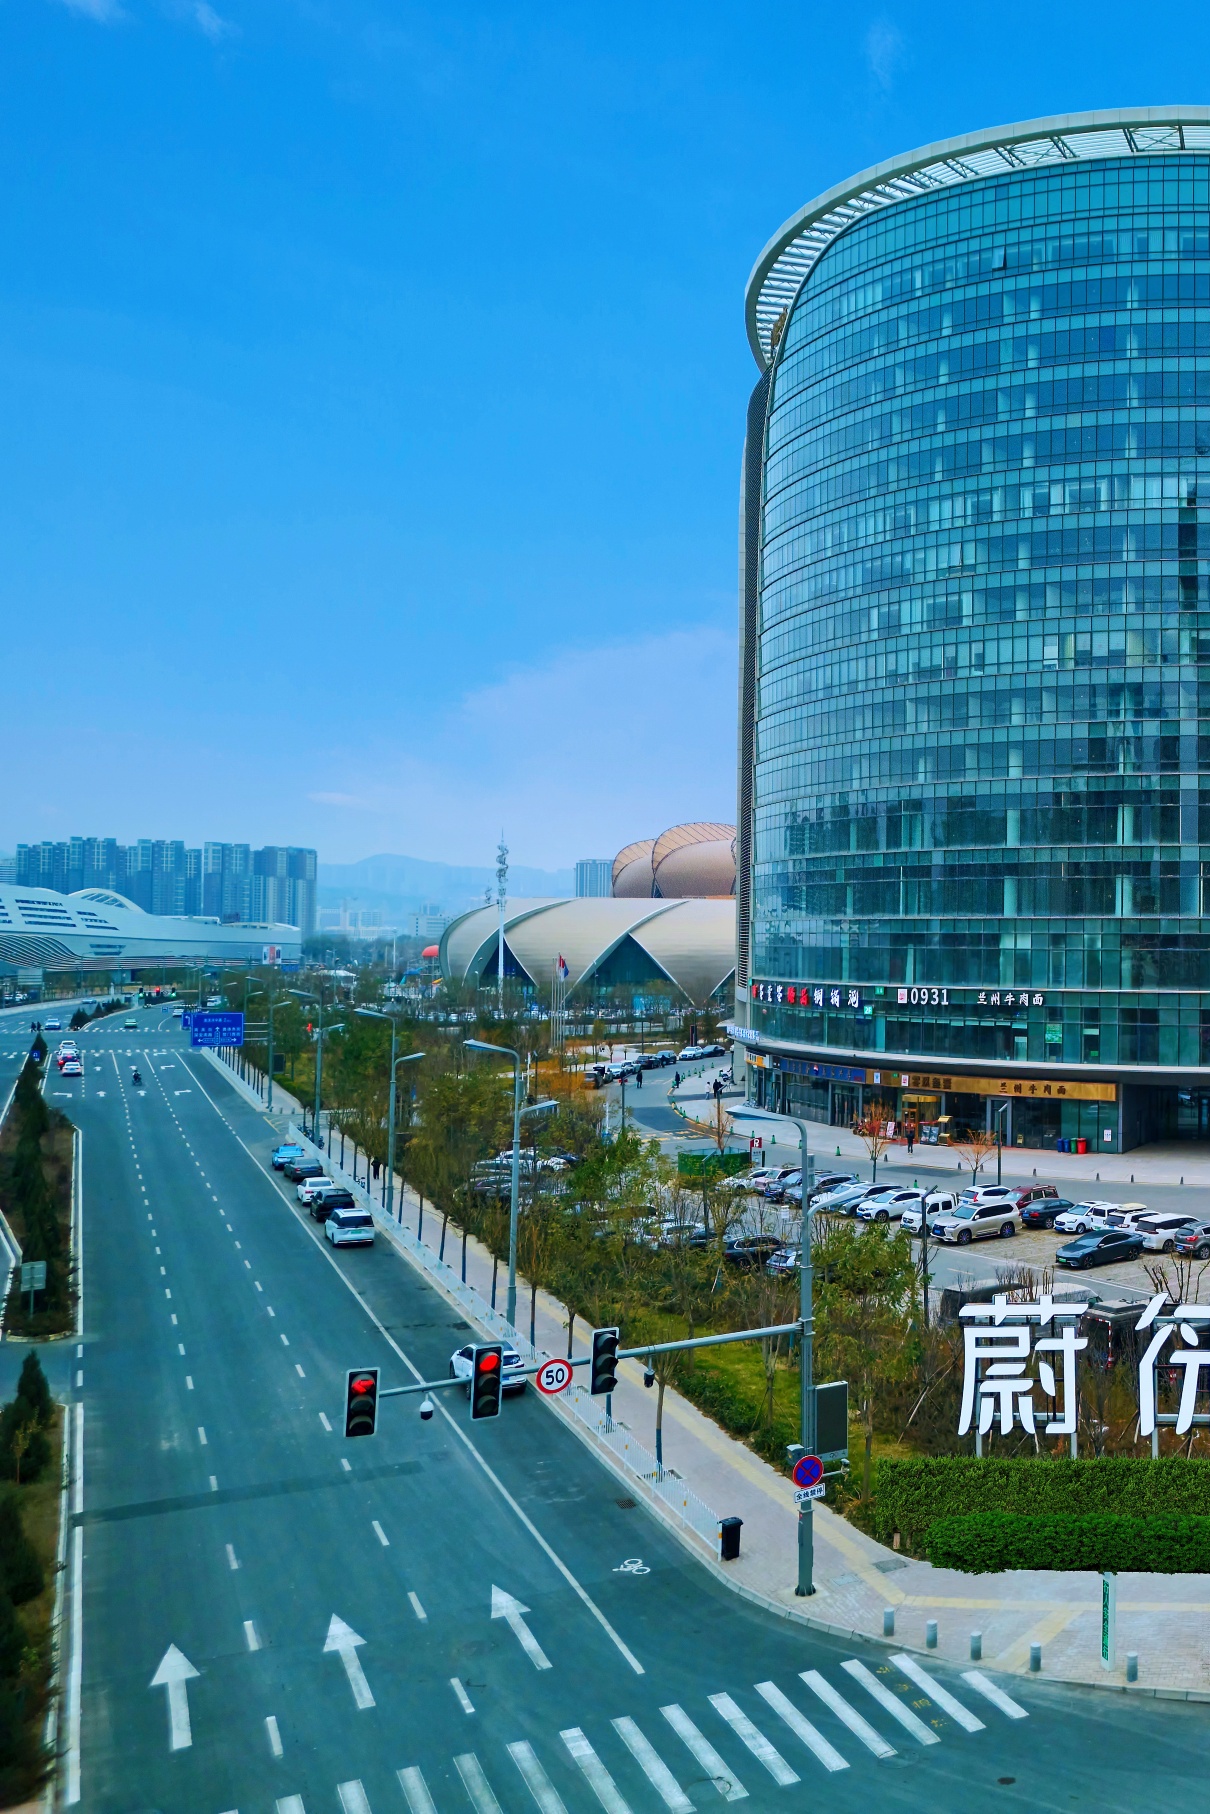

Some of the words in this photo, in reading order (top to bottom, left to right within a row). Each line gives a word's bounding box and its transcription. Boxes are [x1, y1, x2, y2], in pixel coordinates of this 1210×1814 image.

[910, 987, 949, 1006] 0931
[976, 992, 1044, 1007] 兰州牛肉面
[999, 1082, 1067, 1096] 兰州牛肉面
[545, 1367, 565, 1386] 50
